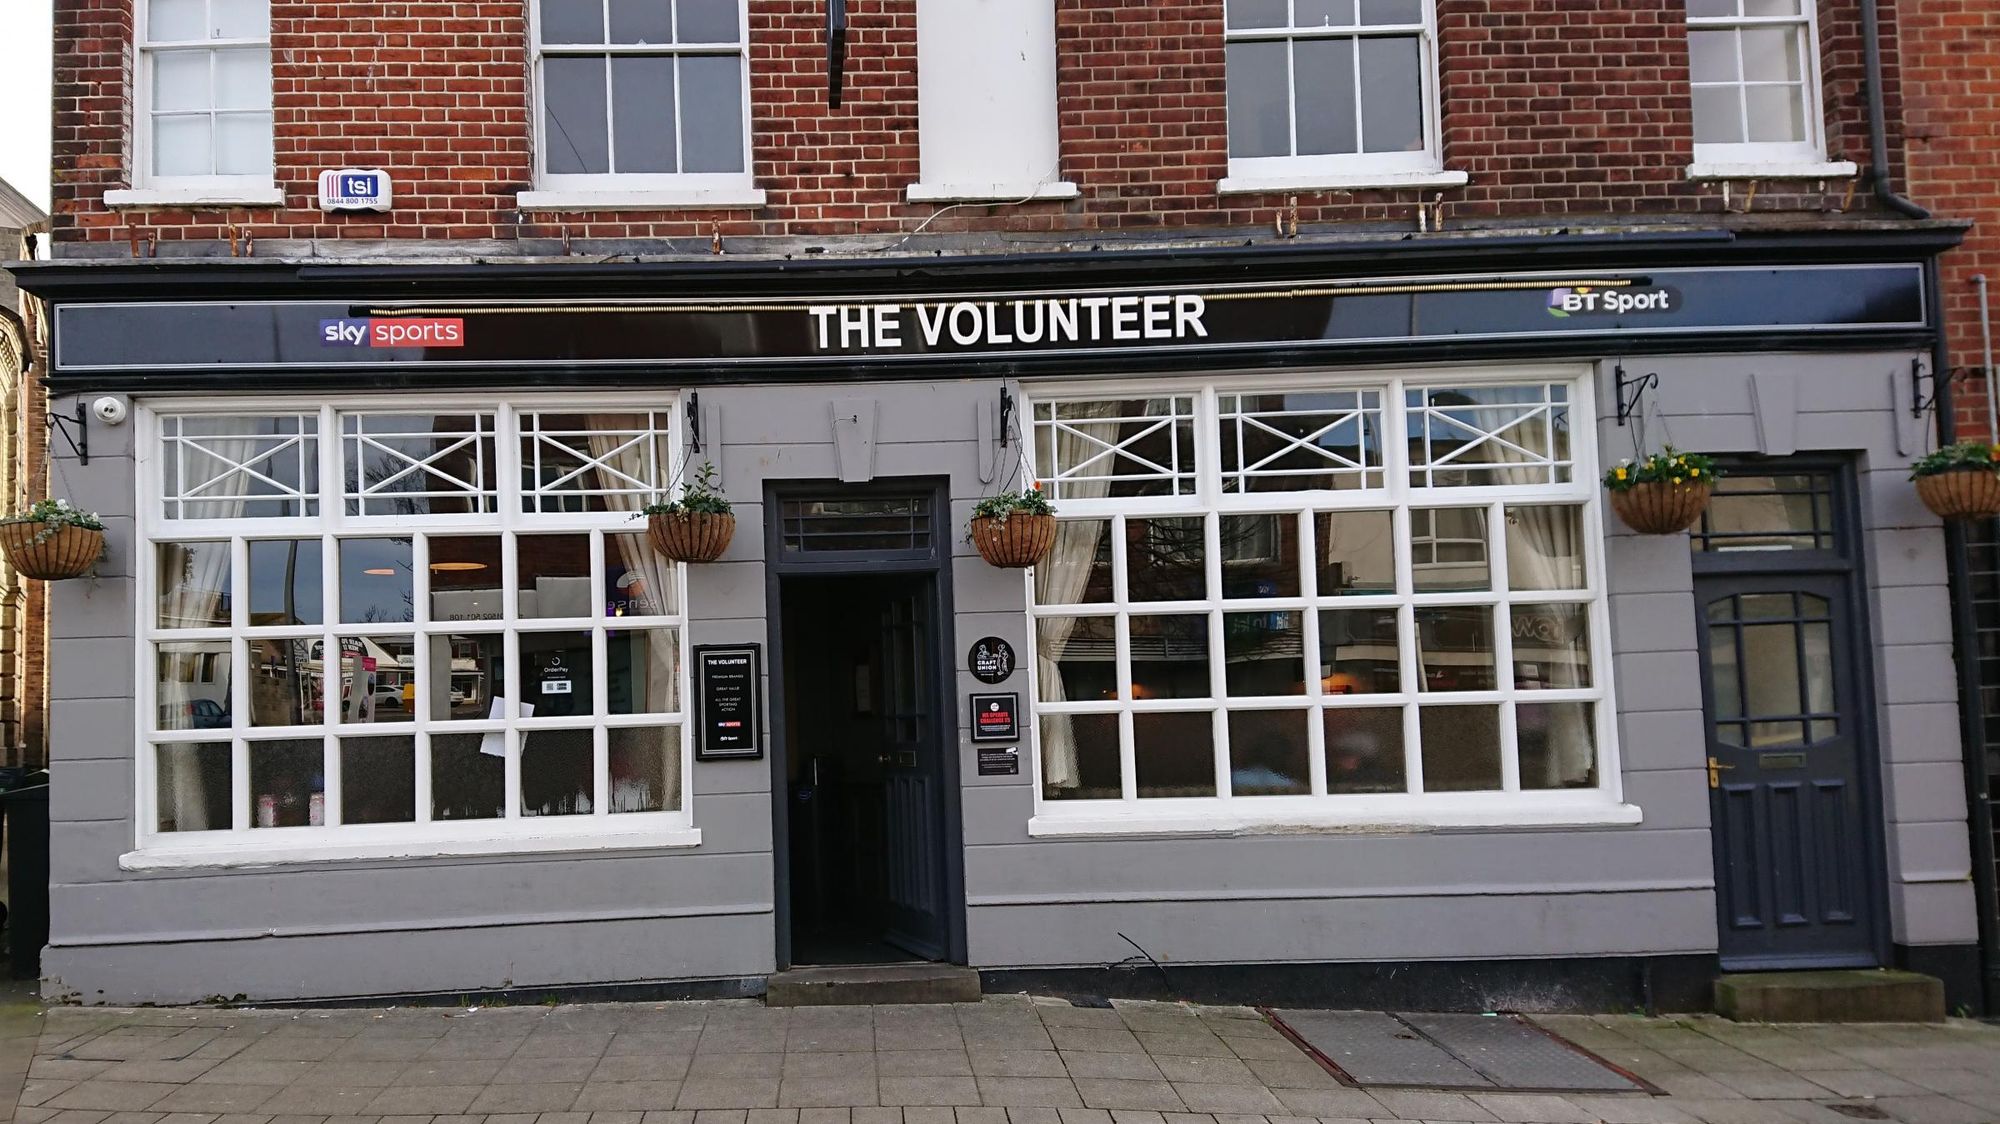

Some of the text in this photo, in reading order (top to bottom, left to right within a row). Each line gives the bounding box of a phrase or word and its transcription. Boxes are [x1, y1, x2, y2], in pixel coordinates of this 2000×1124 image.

[347, 177, 371, 195] tsi
[1562, 289, 1669, 314] BT Sport
[324, 320, 459, 346] sky sports
[808, 294, 1209, 349] THE VOLUNTEER
